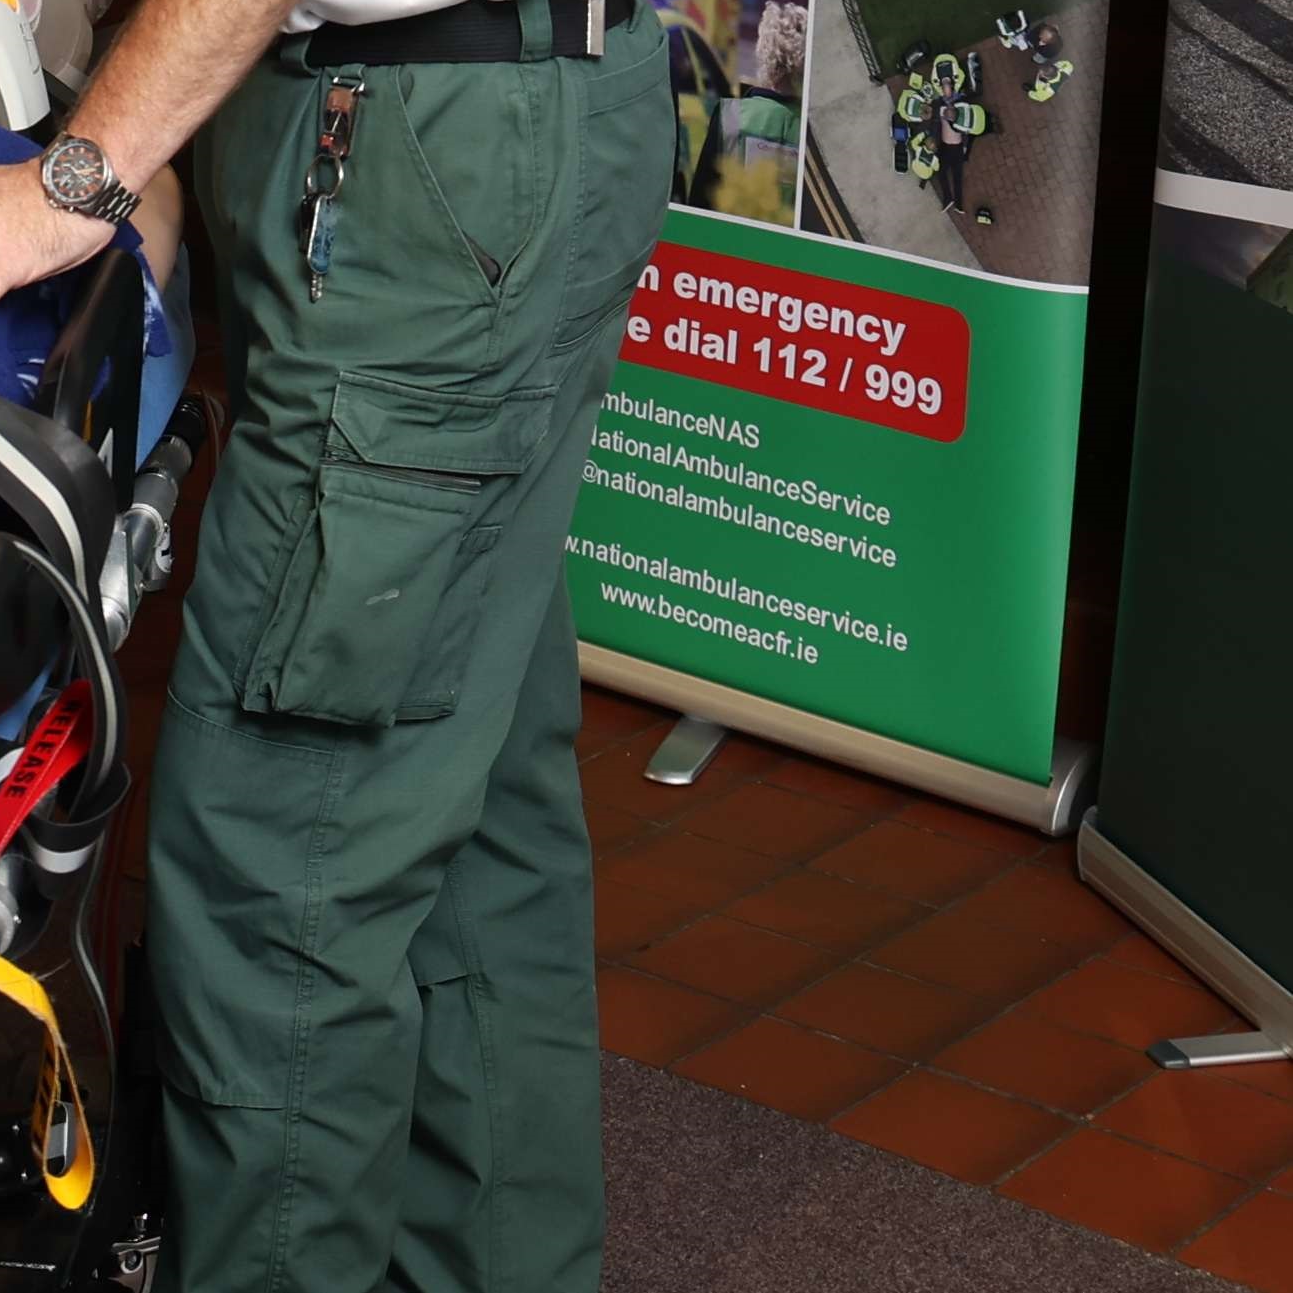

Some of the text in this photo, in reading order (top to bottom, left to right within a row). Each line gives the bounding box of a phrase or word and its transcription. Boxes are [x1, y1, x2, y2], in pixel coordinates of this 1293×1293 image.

[673, 270, 905, 356] emergency
[664, 317, 737, 364] dial
[753, 341, 826, 387] 112
[839, 357, 852, 392] /
[866, 365, 942, 415] 999
[602, 392, 760, 448] mbulanceNAS
[582, 460, 896, 568] @nationalambulanceservice
[591, 425, 890, 526] ationalAmbulanceService
[564, 535, 908, 651] w.nationalambulanceservice.ie
[602, 581, 819, 664] www.becomeacfr.ie
